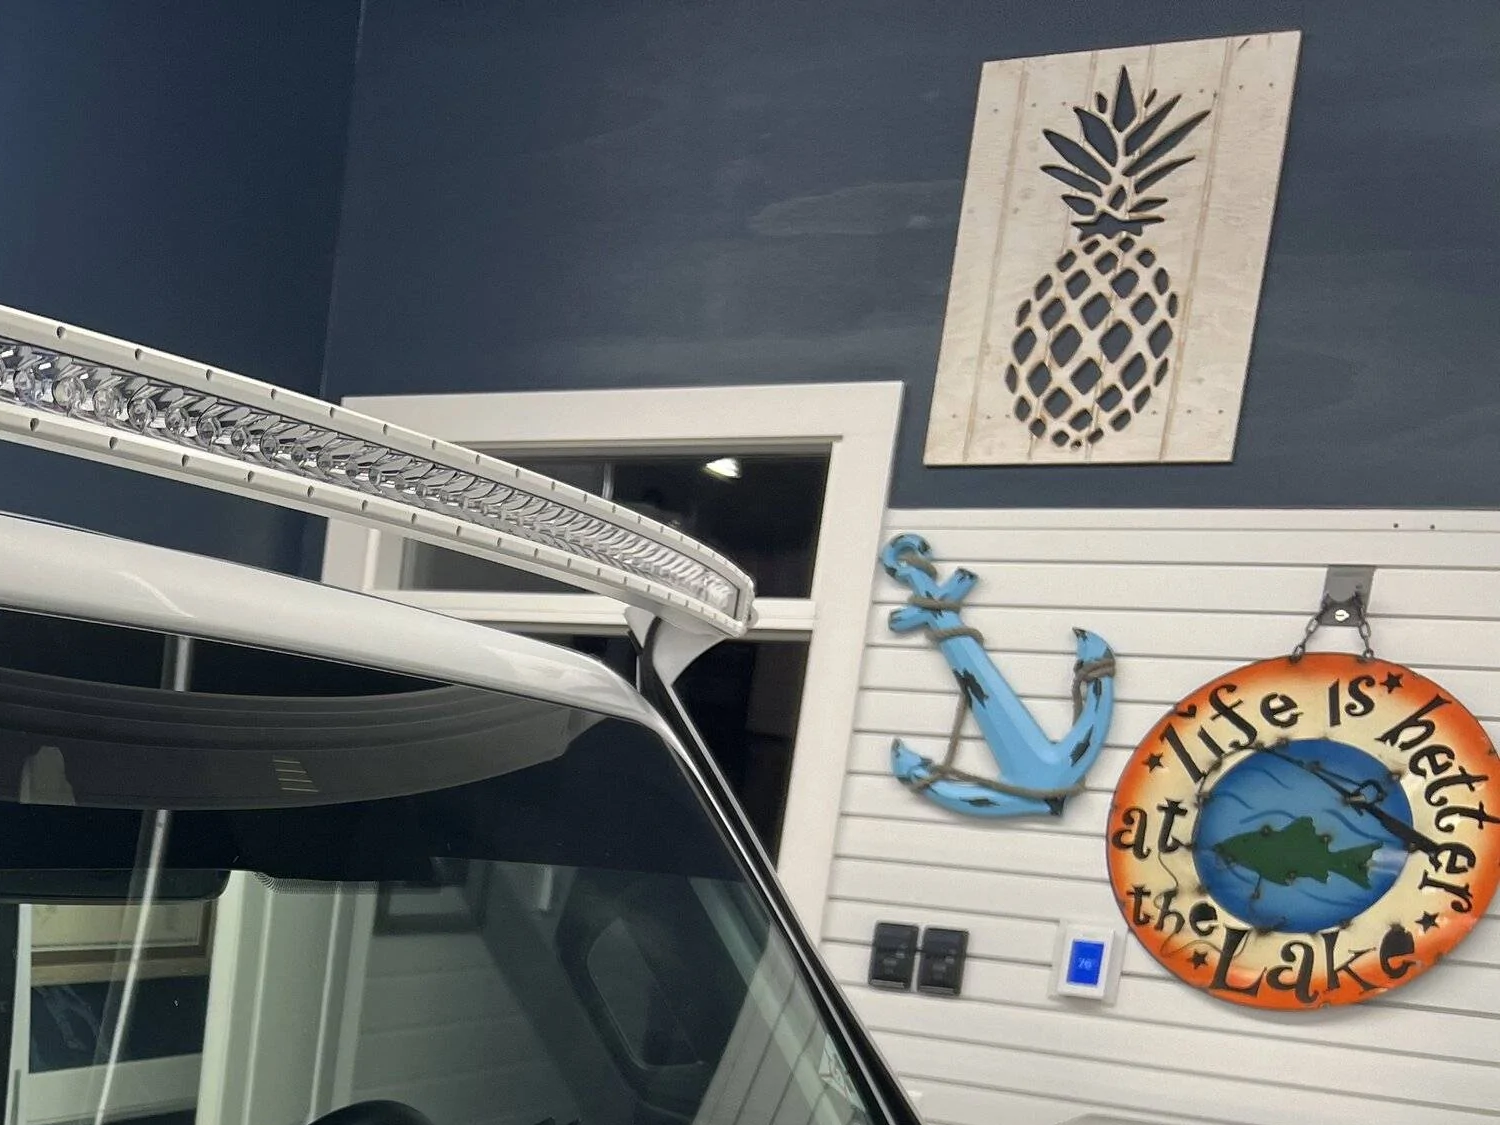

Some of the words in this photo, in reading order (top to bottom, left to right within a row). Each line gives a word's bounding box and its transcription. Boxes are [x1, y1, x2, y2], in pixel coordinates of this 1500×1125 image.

[1111, 798, 1192, 861] at
[1375, 693, 1500, 914] better
[1127, 884, 1220, 937] the
[1210, 922, 1422, 1003] Lake
